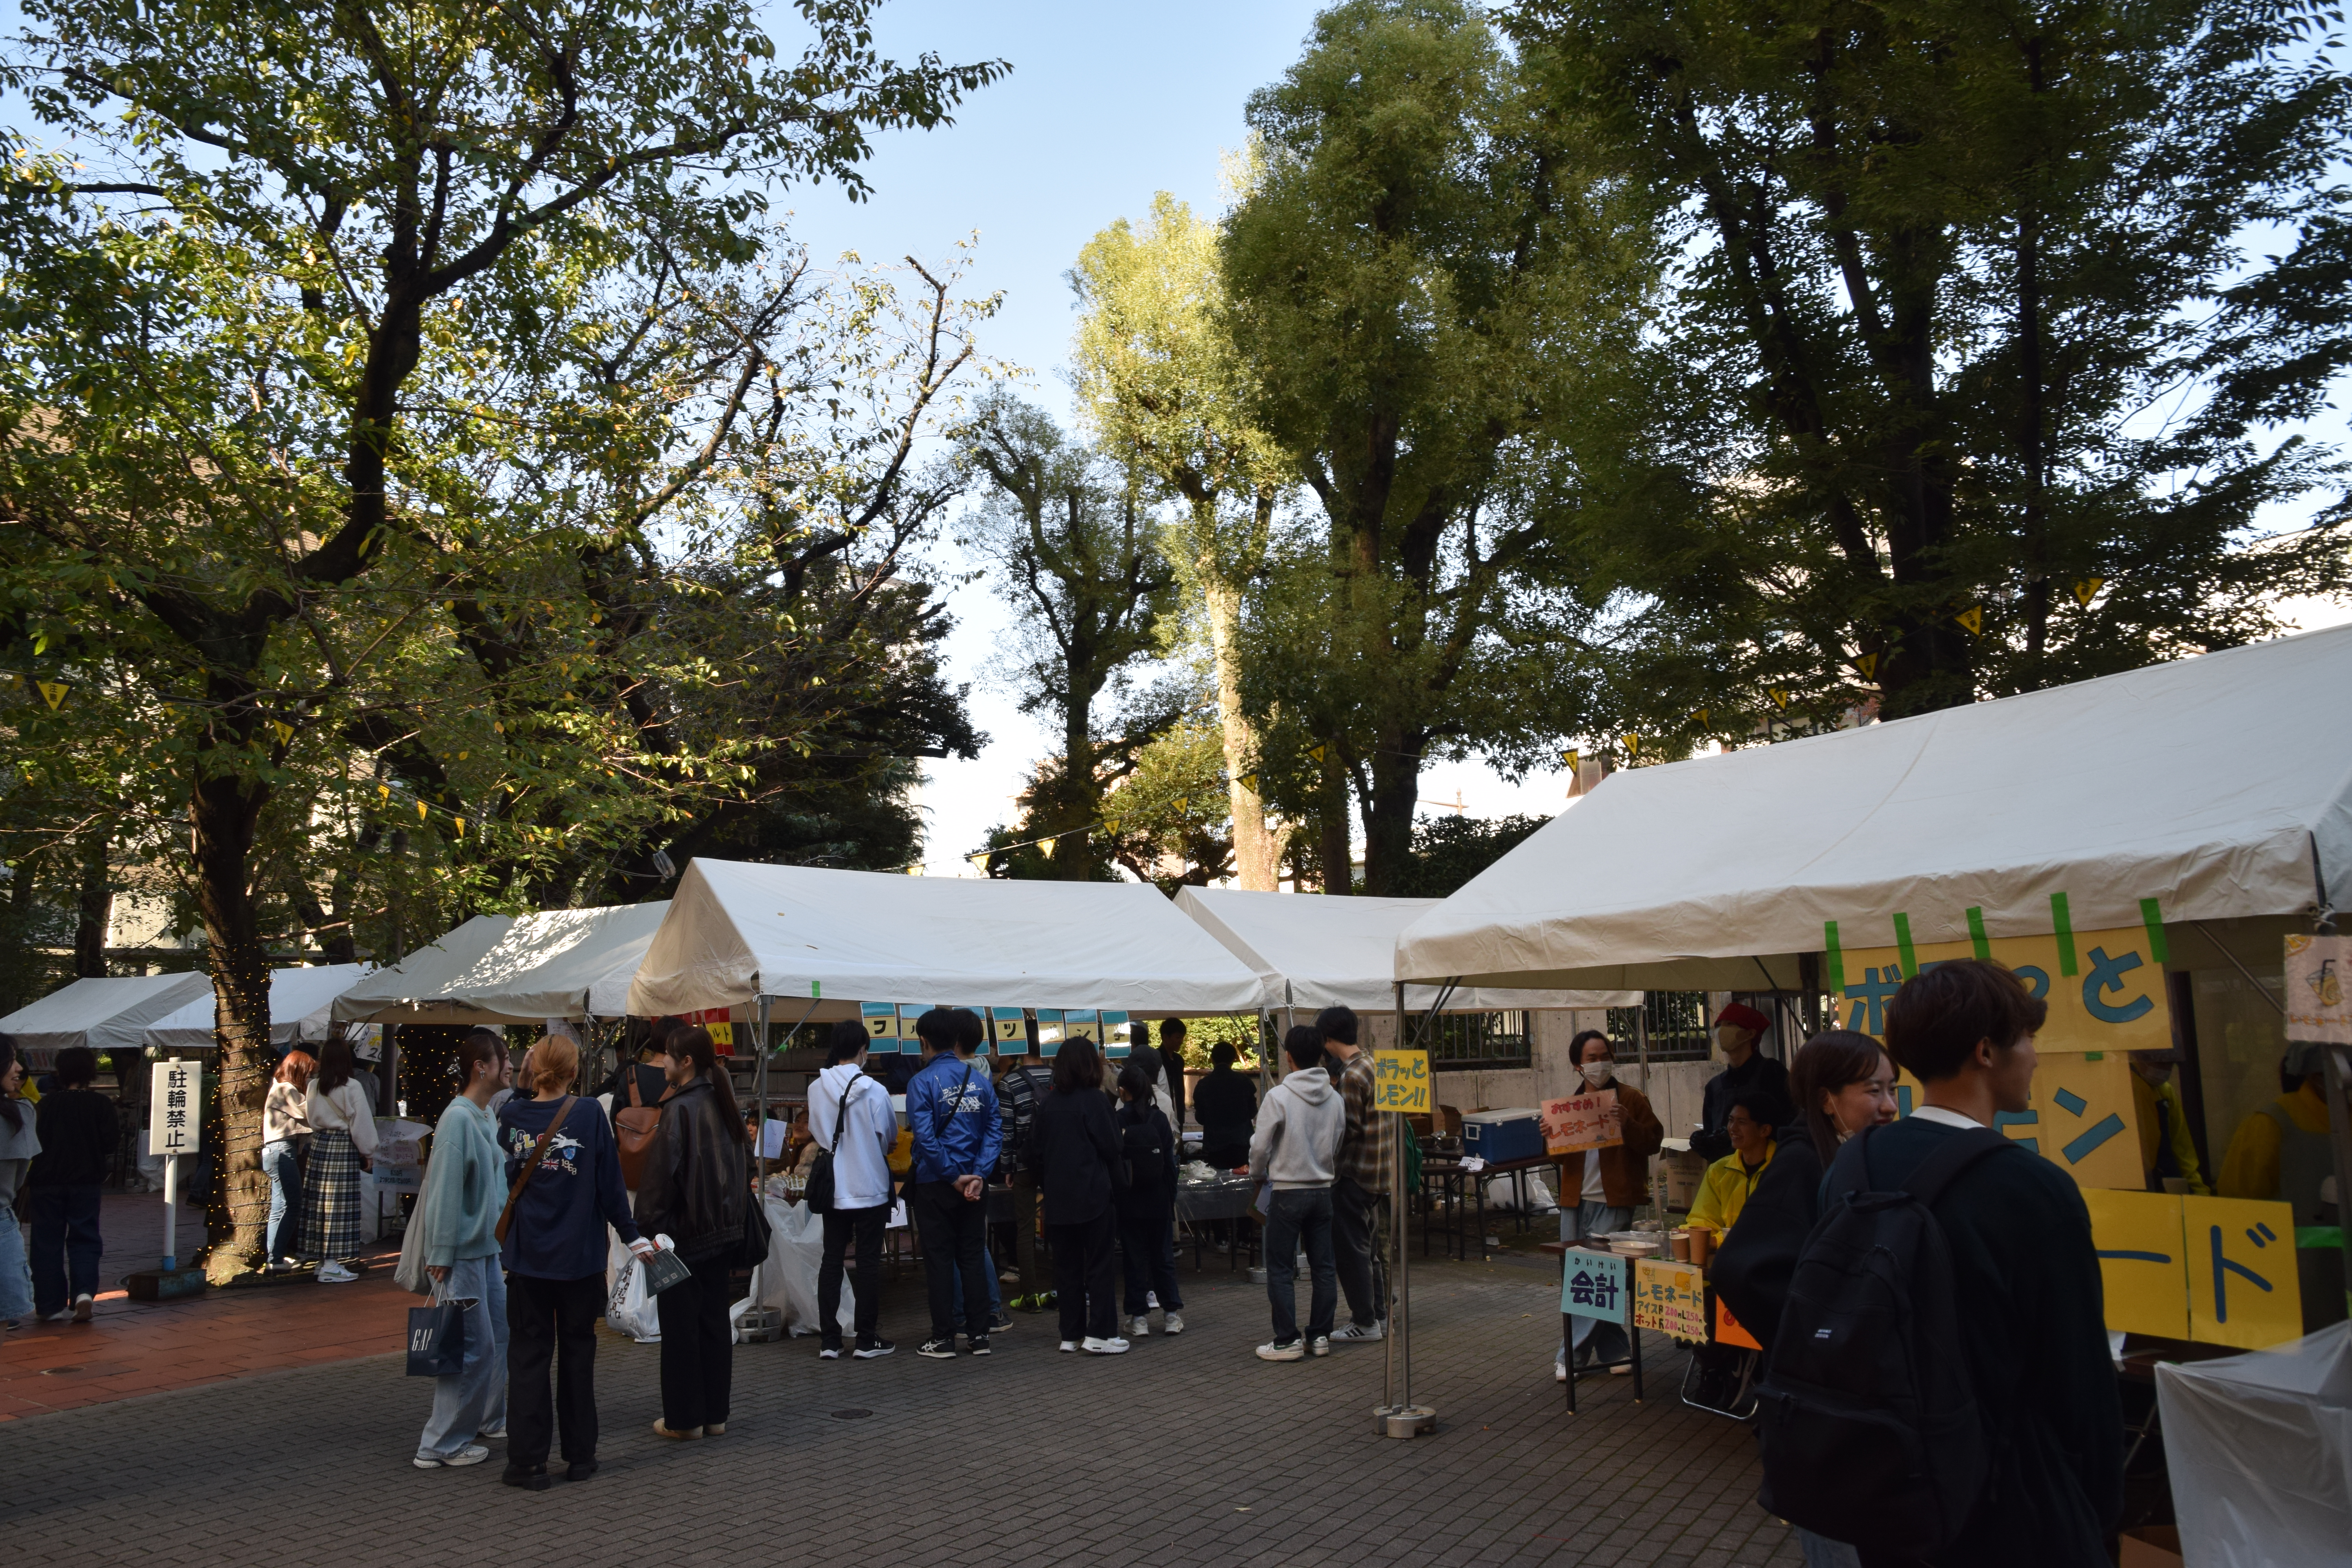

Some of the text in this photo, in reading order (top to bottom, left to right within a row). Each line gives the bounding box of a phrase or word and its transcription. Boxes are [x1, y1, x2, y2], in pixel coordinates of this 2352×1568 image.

[49, 684, 58, 702] 注意
[281, 725, 287, 739] 注意
[165, 1069, 187, 1147] 駐輪禁止
[1549, 1114, 1610, 1139] レモネード
[561, 1158, 577, 1175] 1968
[1575, 1257, 1616, 1270] かいけい
[1570, 1270, 1619, 1310] 会計
[1637, 1281, 1702, 1307] レモネード
[412, 1328, 433, 1351] GAP
